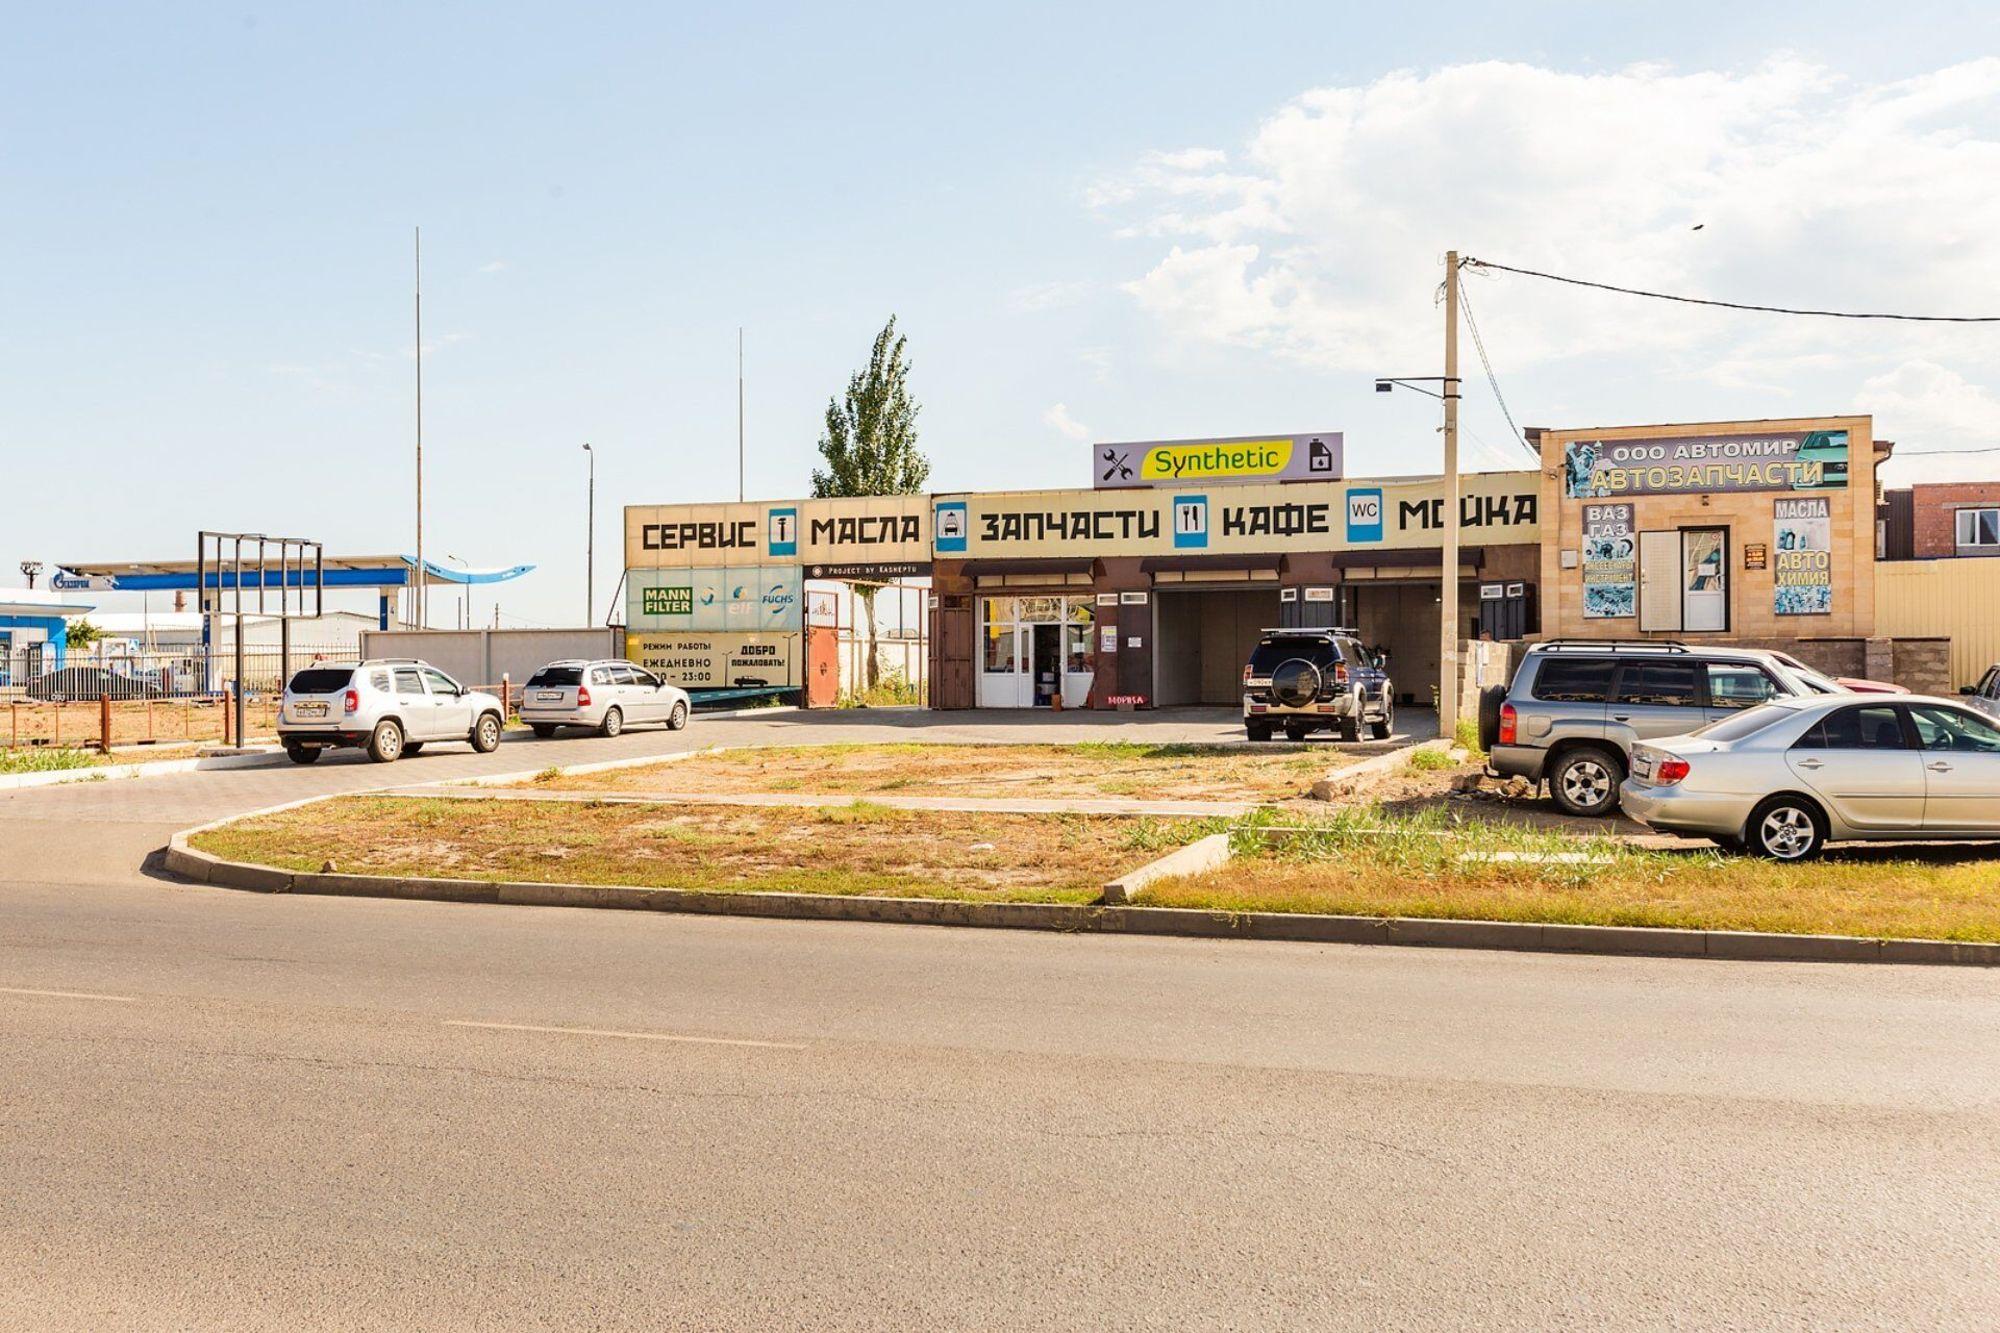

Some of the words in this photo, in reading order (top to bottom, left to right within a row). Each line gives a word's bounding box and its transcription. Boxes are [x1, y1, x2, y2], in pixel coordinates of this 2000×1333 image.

[1613, 447, 1665, 461] ООО
[1673, 439, 1798, 460] АВТОМИР
[1156, 446, 1278, 478] Synthetic
[1591, 461, 1825, 490] АВТОЗАПЧАСТИ
[1352, 502, 1377, 518] WC
[1588, 506, 1629, 521] ВАЗ
[1775, 500, 1828, 518] МАСЛА
[980, 510, 1160, 541] ЗАПЧАСТИ
[1223, 503, 1330, 537] КАФЕ
[642, 521, 756, 550] СЕРВИС
[811, 515, 920, 545] МАСЛА
[1589, 523, 1627, 537] ГАЗ
[1778, 551, 1828, 570] АВТО
[1779, 570, 1829, 586] ХИМИЯ
[645, 589, 691, 600] MANN
[762, 595, 794, 604] FUCHS
[645, 601, 691, 612] FILTER
[741, 645, 776, 656] ДОБРО
[643, 658, 711, 668] ЕЖЕДНЕВНО
[731, 658, 785, 667] ПОЖАЛОВАТЬ!
[682, 672, 711, 681] 23:00
